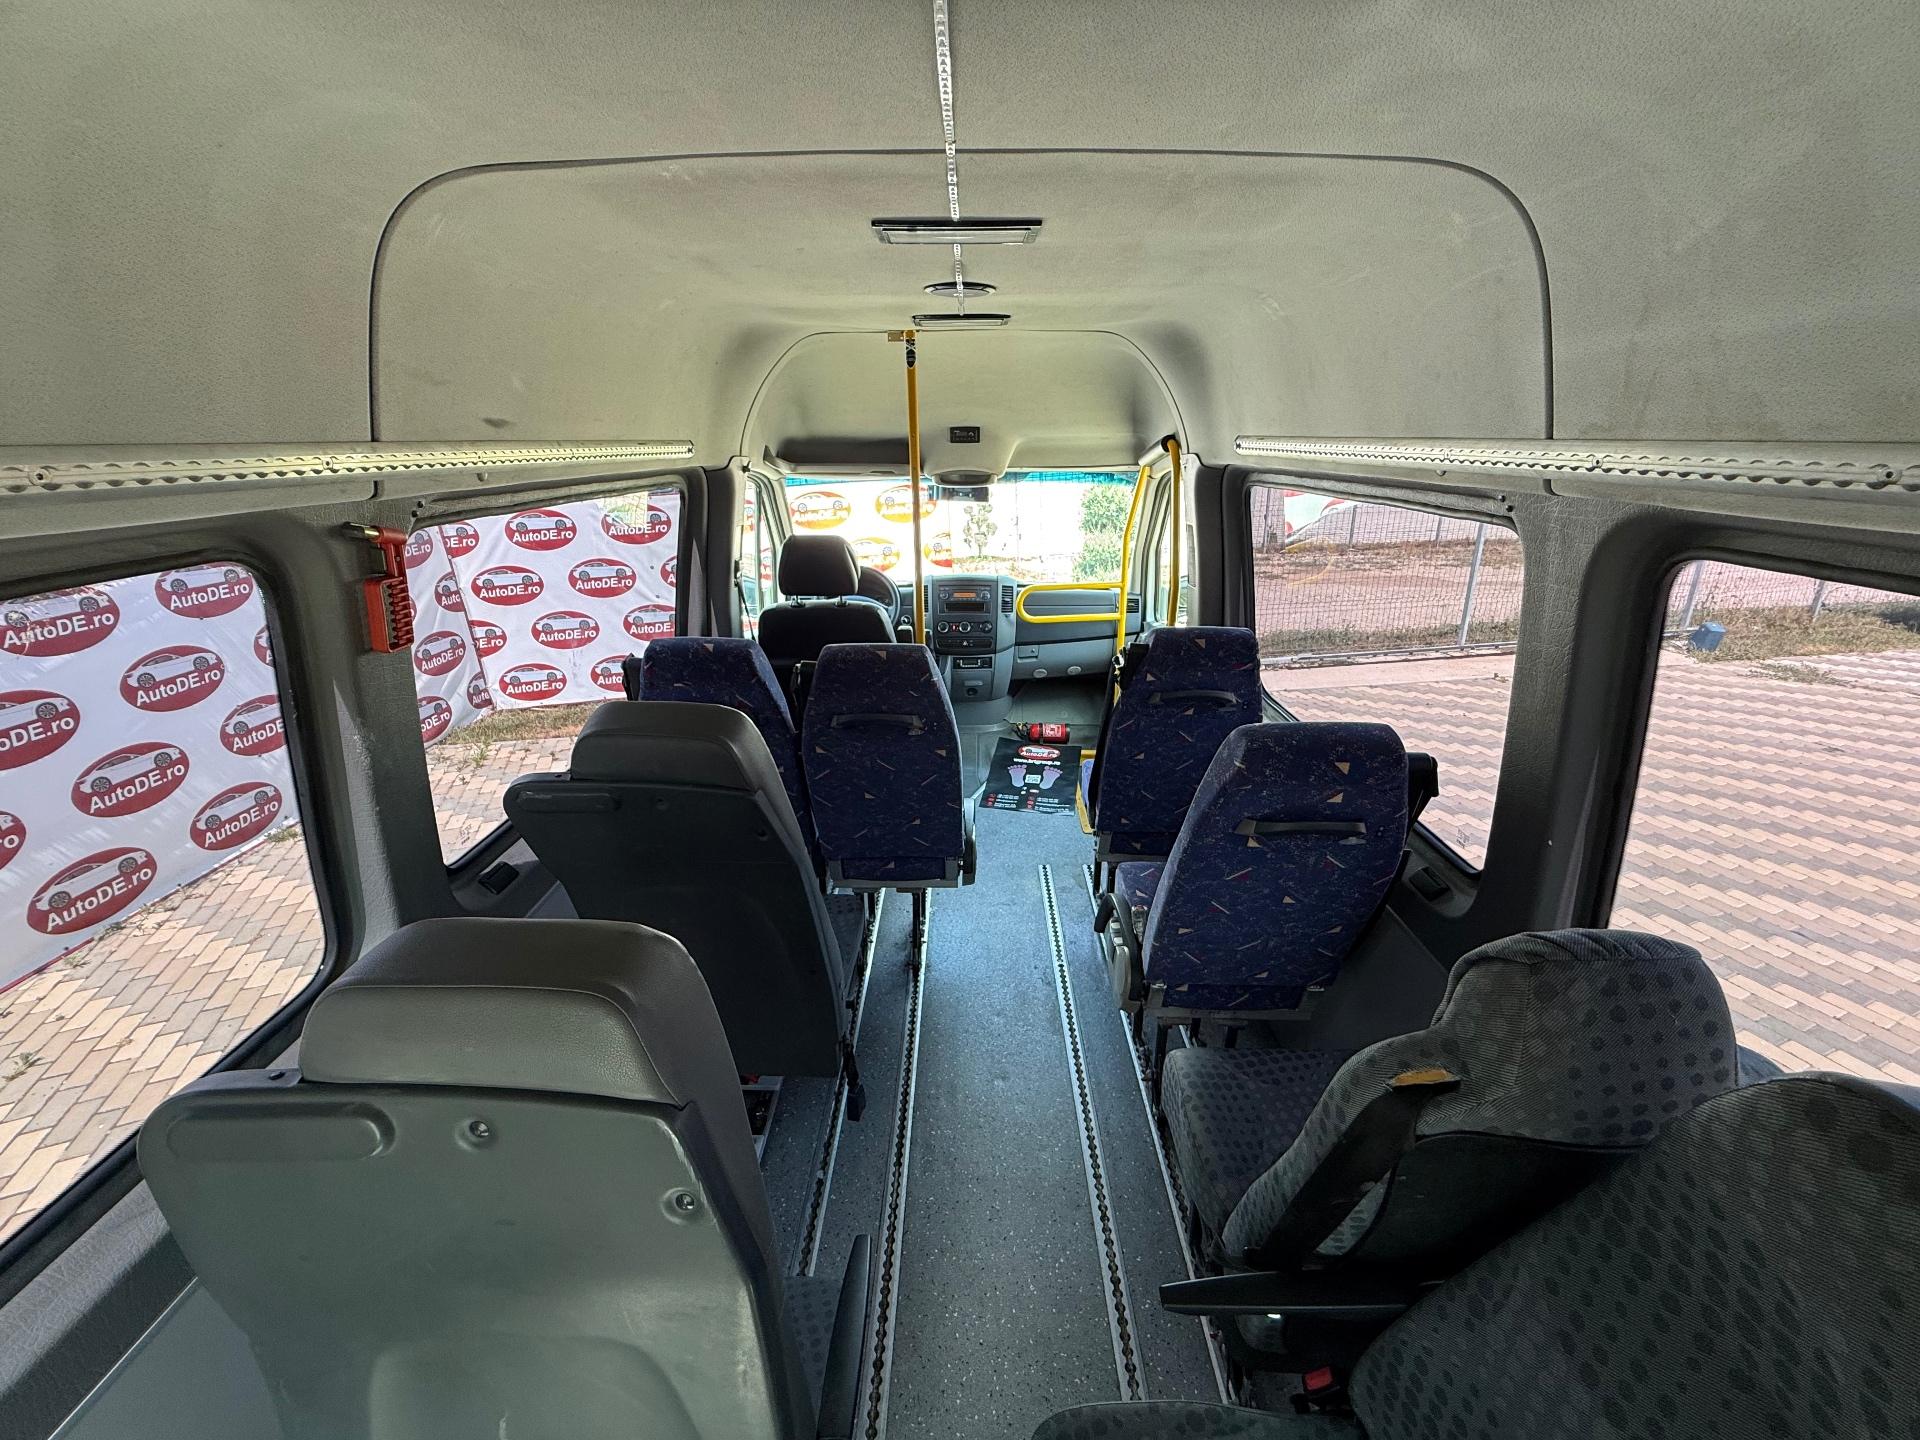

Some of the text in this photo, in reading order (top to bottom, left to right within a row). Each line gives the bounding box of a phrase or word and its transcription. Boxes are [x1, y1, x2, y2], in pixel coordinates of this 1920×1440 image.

[512, 529, 573, 542] AutoDE.ro
[608, 522, 667, 535] AutoDE.ro
[480, 585, 541, 598] AutoDE.ro
[575, 578, 633, 590] AutoDE.ro
[170, 583, 250, 610] AutoDE.ro
[3, 613, 115, 649] AutoDE.ro
[538, 630, 597, 642] AutoDE.ro
[629, 622, 674, 634] AutoDE.
[421, 648, 464, 672] AutoDE.ro
[135, 669, 221, 707] AutoDE.ro
[506, 681, 563, 694] AutoDE.ro
[0, 717, 75, 751] oDE.ro
[421, 712, 450, 732] oDE.ro
[233, 719, 284, 751] AutoDE
[89, 764, 185, 814] AutoDE.ro
[204, 801, 278, 847] AutoDE.ro
[46, 867, 152, 932] AutoDE.ro
